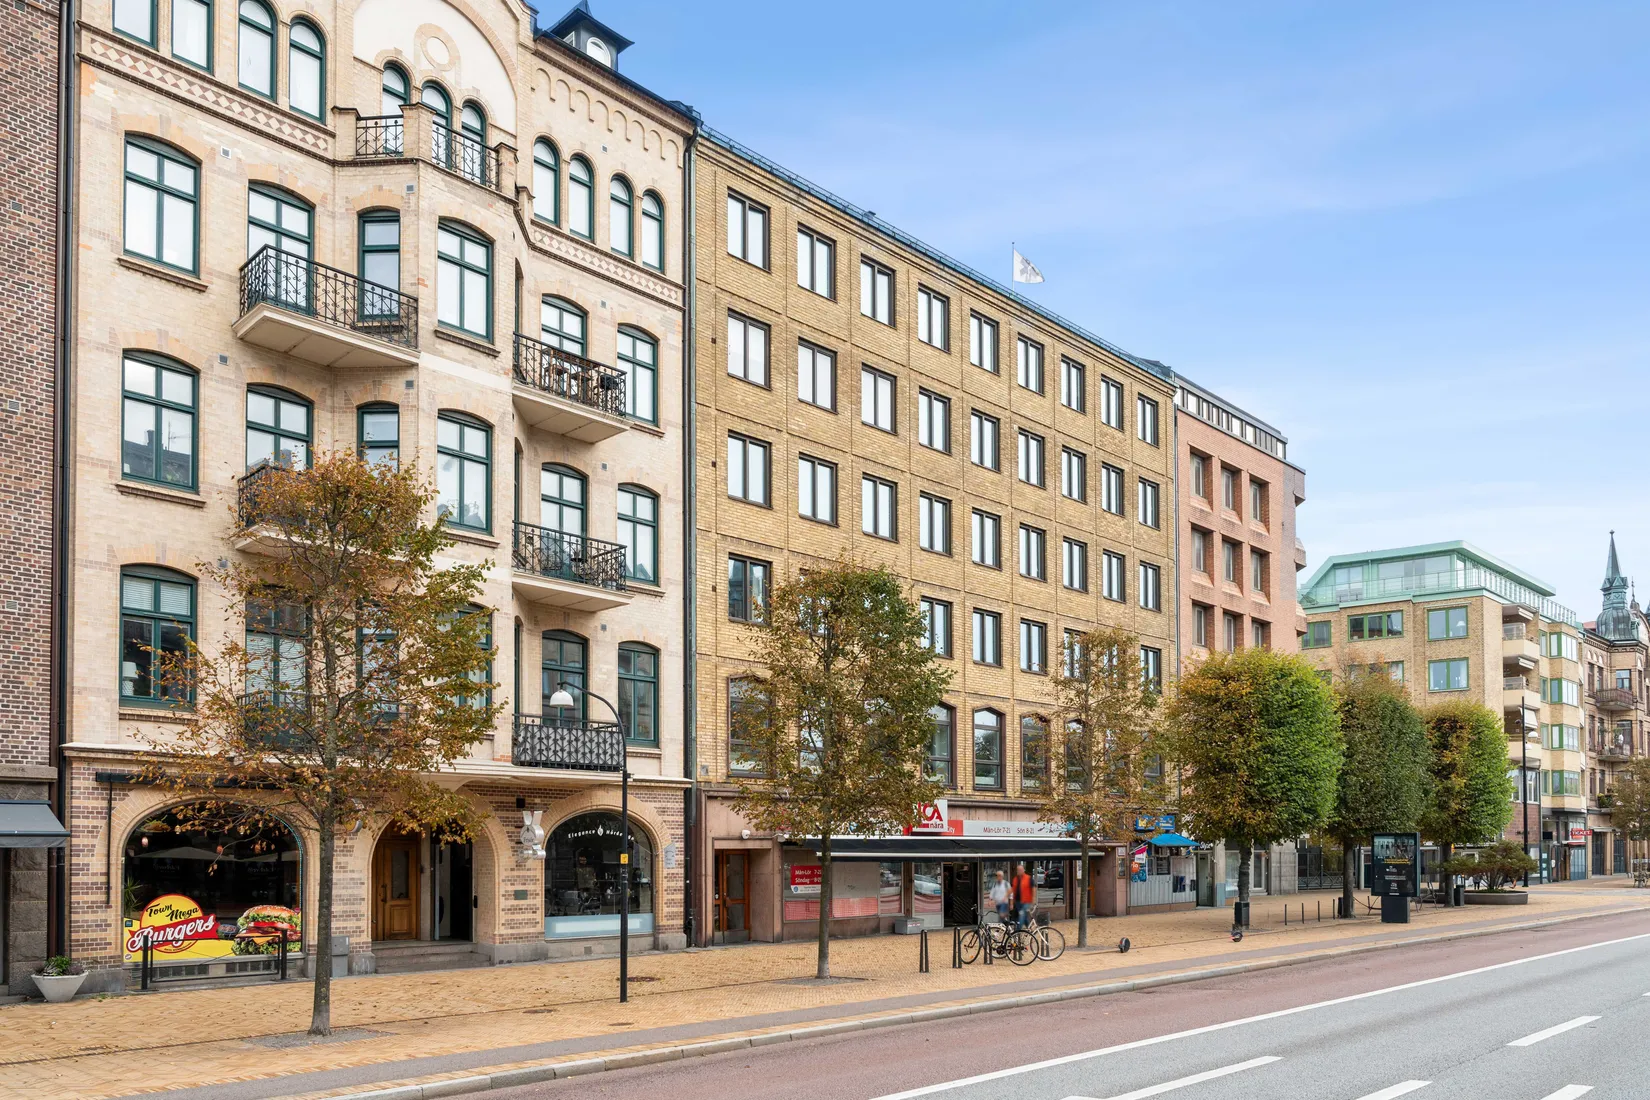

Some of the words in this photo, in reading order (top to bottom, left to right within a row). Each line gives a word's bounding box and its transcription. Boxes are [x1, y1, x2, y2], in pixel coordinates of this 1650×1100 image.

[568, 829, 596, 839] Elegance
[146, 903, 172, 917] Town
[166, 907, 199, 921] Mega
[127, 914, 215, 952] Burgers
